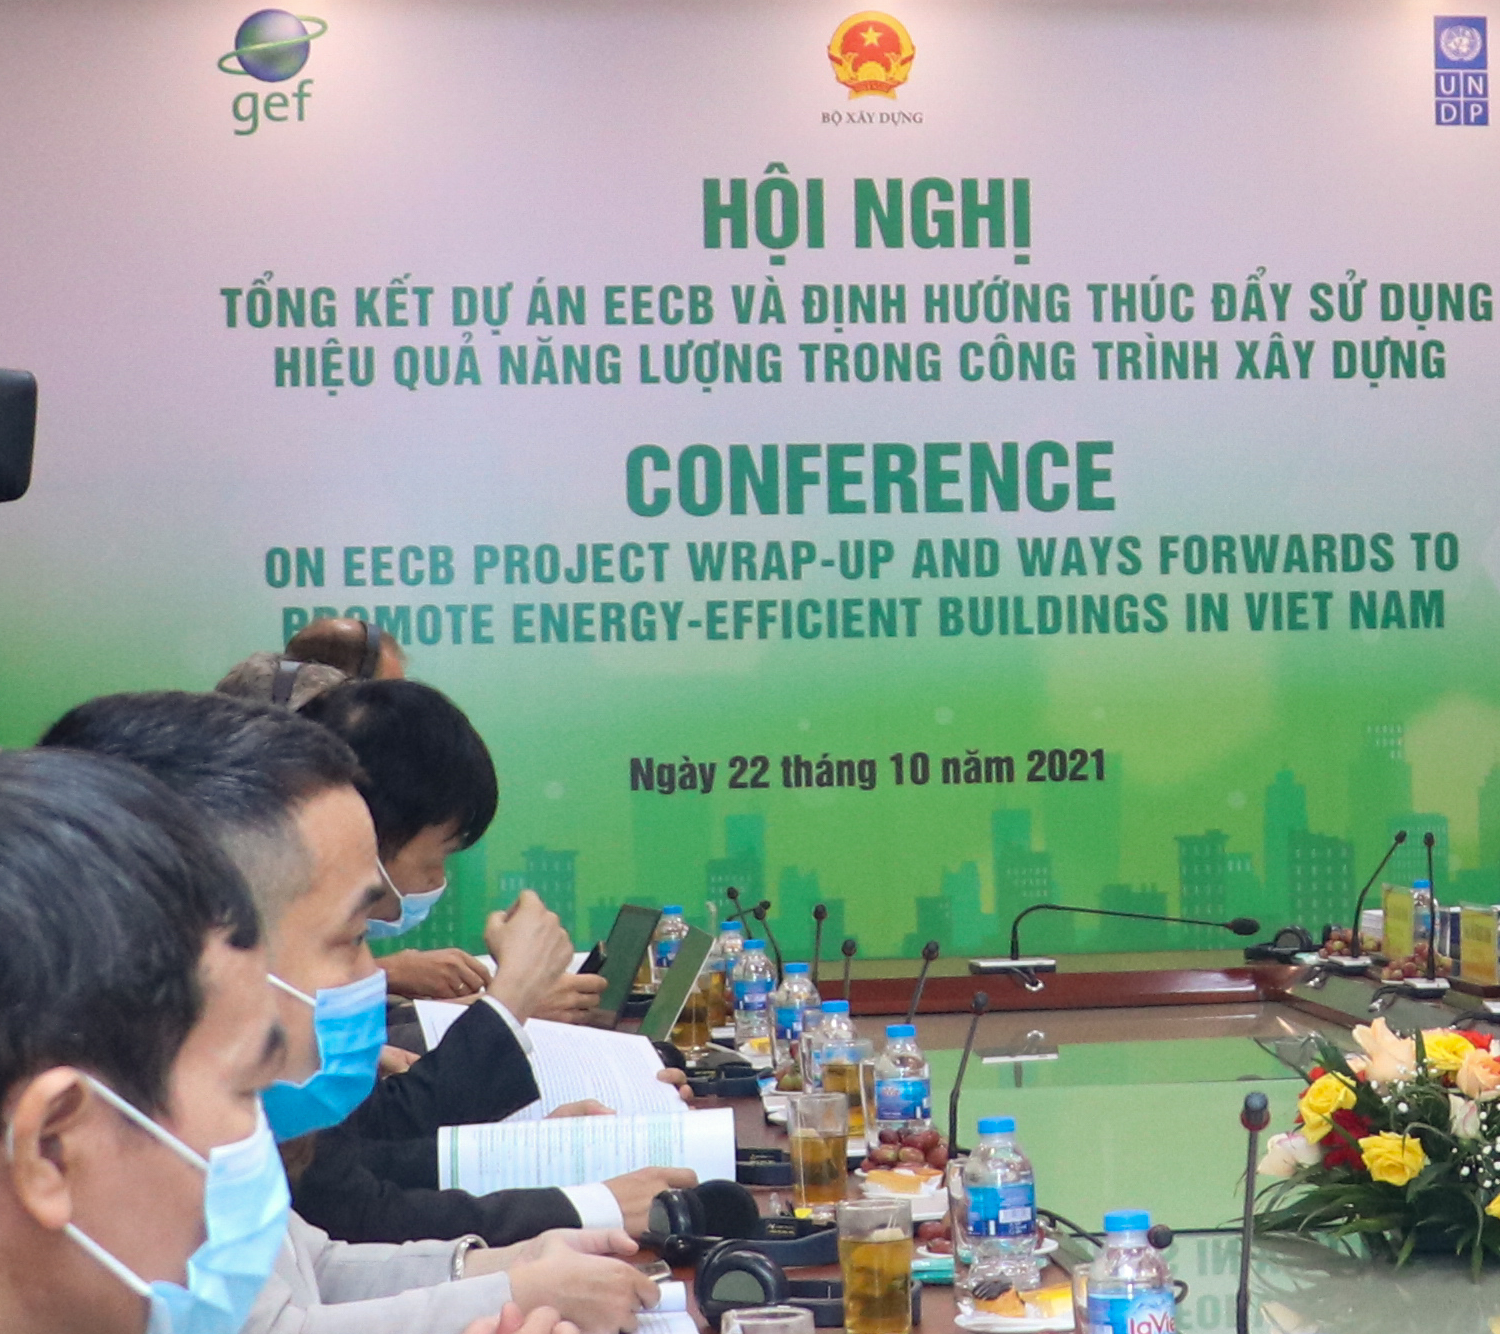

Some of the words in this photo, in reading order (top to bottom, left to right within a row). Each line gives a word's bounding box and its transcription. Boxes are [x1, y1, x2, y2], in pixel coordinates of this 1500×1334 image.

[232, 80, 314, 135] gef
[821, 109, 843, 126] BỘ
[846, 108, 875, 124] XÂY
[879, 109, 924, 126] DỰNG
[702, 161, 825, 266] HỘI
[854, 177, 1031, 265] NGHỊ
[220, 270, 336, 328] TỔNG
[355, 272, 435, 327] KẾT
[452, 282, 514, 335] DỰ
[526, 277, 586, 326] ÁN
[604, 284, 715, 325] EECB
[731, 275, 786, 324] VÀ
[802, 283, 906, 333] ĐỊNH
[924, 275, 1070, 324] HƯỚNG
[1087, 274, 1195, 323] THÚC
[1211, 266, 1292, 322] ĐẨY
[1310, 269, 1367, 322] SỬ
[1380, 282, 1493, 331] DỤNG
[274, 338, 375, 396] HIỆU
[393, 331, 481, 391] QUẢ
[499, 335, 621, 386] NĂNG
[640, 339, 782, 393] LƯỢNG
[799, 341, 941, 383] TRONG
[960, 332, 1076, 382] CÔNG
[1092, 332, 1218, 380] TRÌNH
[1235, 331, 1315, 380] XÂY
[1333, 336, 1446, 388] DỰNG
[626, 440, 1116, 517] CONFERENCE
[265, 546, 325, 588] ON
[344, 544, 454, 587] EECB
[474, 542, 669, 585] PROJECT
[687, 538, 894, 582] WRAP-UP
[912, 538, 999, 579] AND
[1018, 536, 1142, 577] WAYS
[1159, 532, 1395, 575] FORWARDS
[1411, 531, 1459, 571] TO
[513, 598, 921, 644] ENERGY-EFFICIENT
[939, 592, 1168, 637] BUILDINGS
[1186, 591, 1229, 633] IN
[1245, 590, 1333, 631] VIET
[1348, 590, 1445, 630] NAM
[629, 755, 717, 795] Ngày
[728, 755, 770, 789] 22
[781, 752, 877, 791] tháng
[890, 751, 930, 786] 10
[942, 749, 1015, 785] năm
[1026, 748, 1106, 783] 2021
